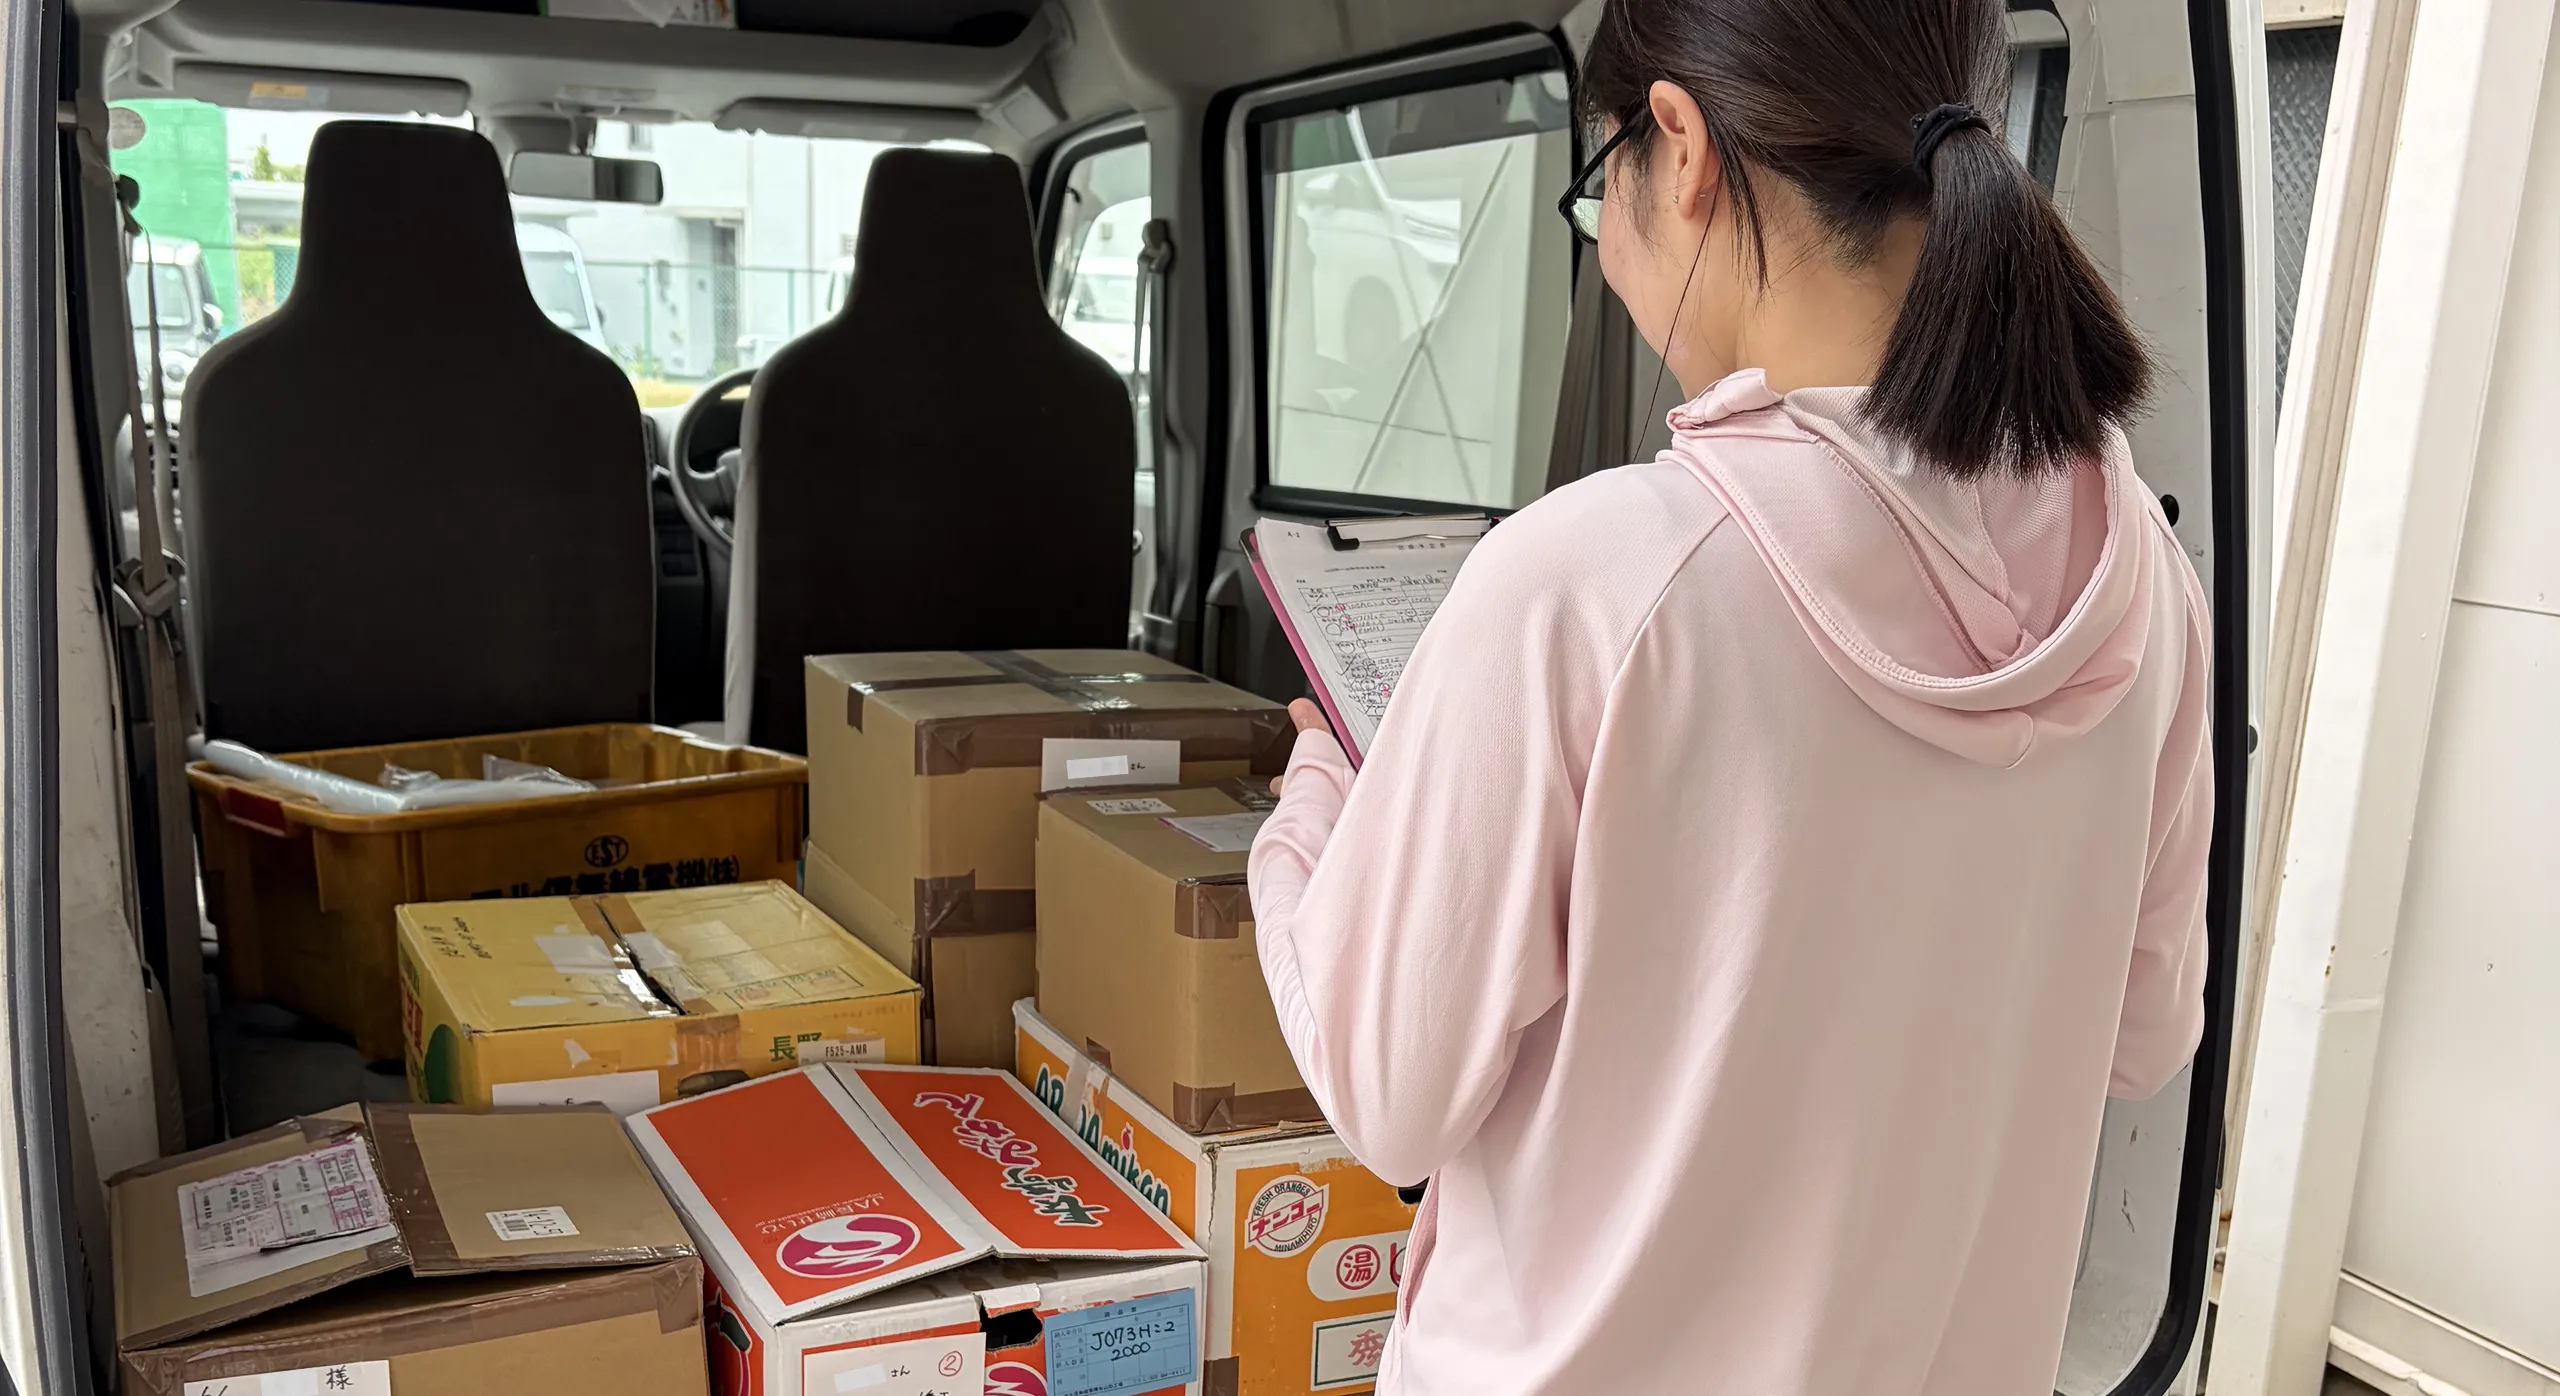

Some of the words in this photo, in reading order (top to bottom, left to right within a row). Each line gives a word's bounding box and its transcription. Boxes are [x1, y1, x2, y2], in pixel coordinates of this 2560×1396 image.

[826, 1044, 867, 1058] F525-AMR
[1254, 1191, 1273, 1216] FRESH
[1274, 1180, 1310, 1196] ORANGES
[1252, 1200, 1320, 1237] ナンコー
[1274, 1217, 1318, 1252] MINAMIHIRO
[1111, 1342, 1151, 1361] 2000
[1348, 1329, 1385, 1367] 秀
[325, 1365, 355, 1391] 様
[890, 1365, 911, 1378] さん
